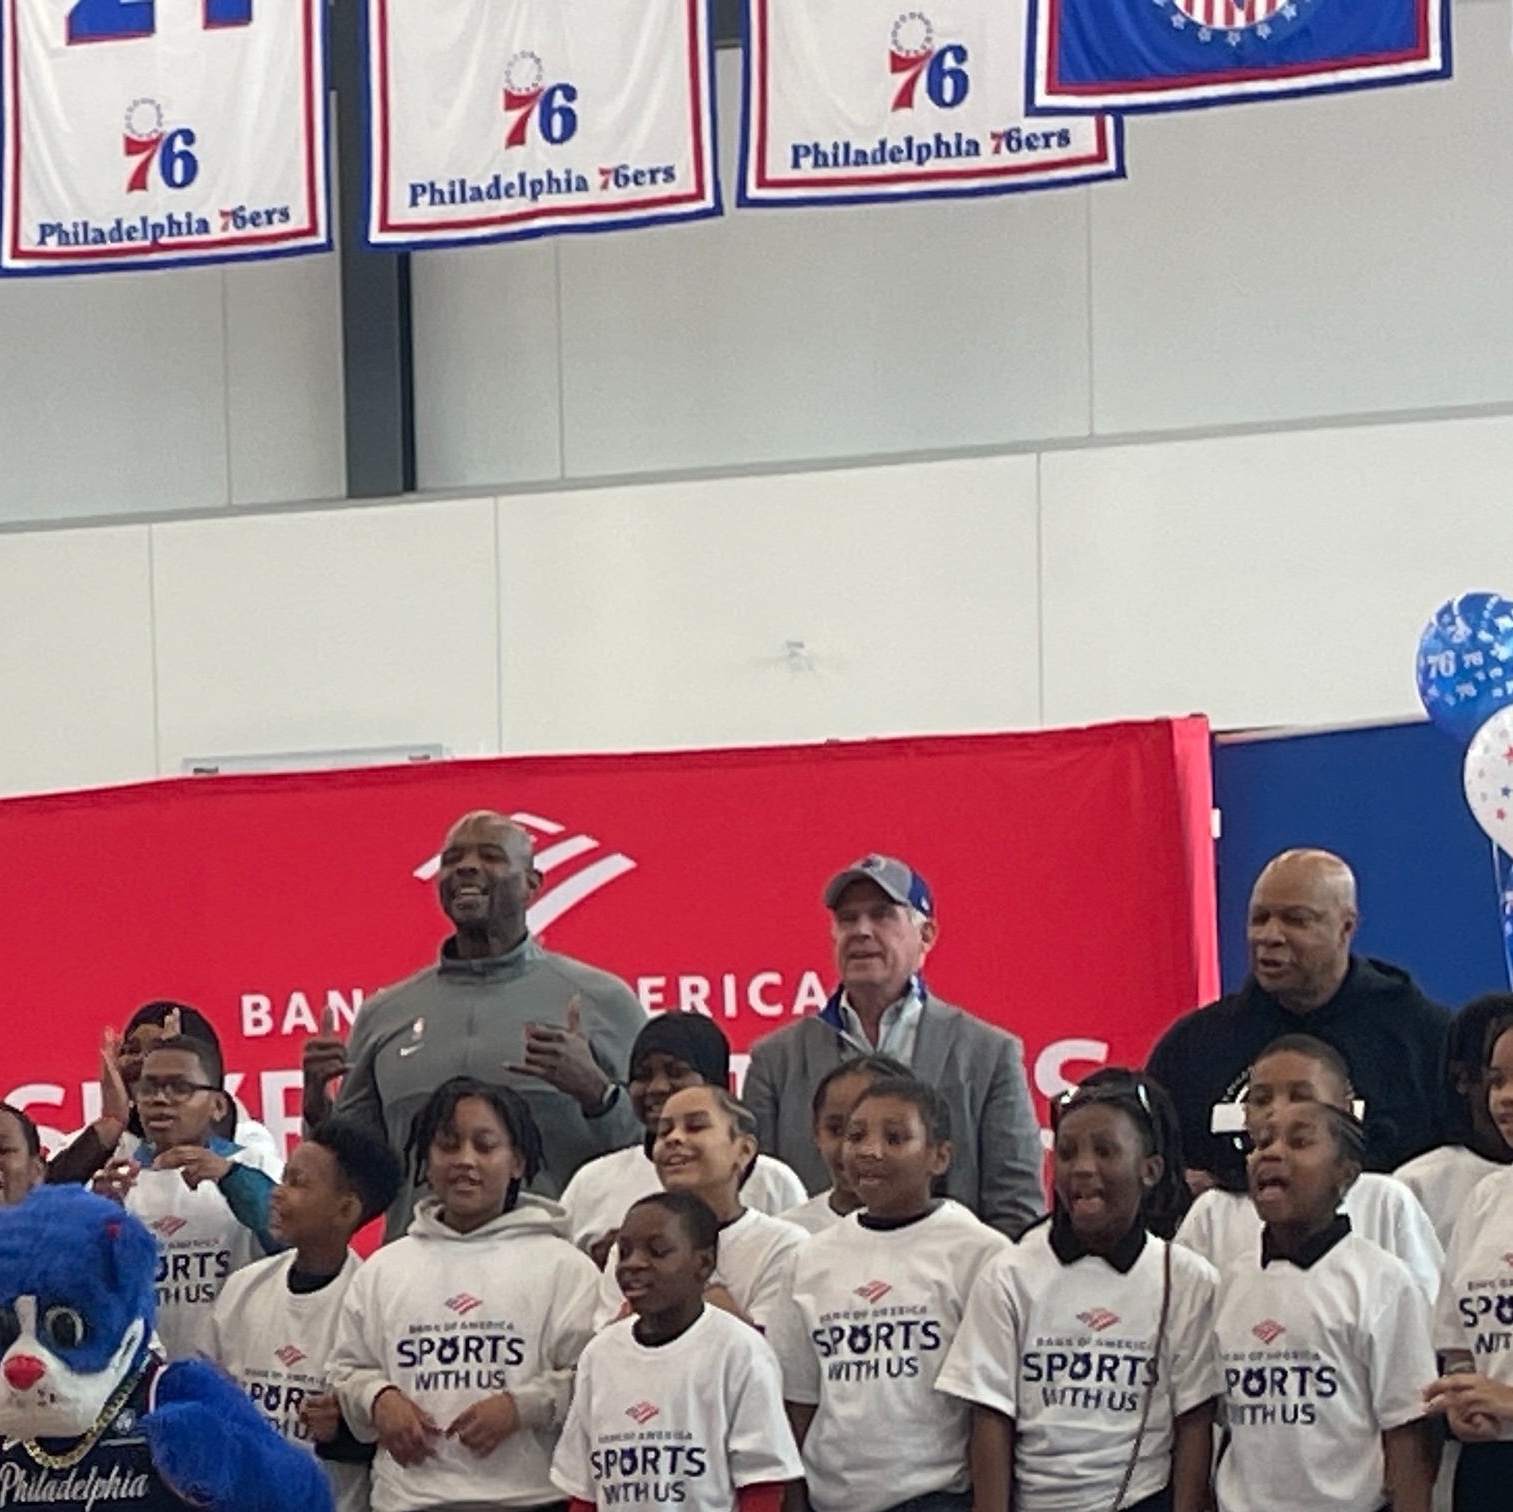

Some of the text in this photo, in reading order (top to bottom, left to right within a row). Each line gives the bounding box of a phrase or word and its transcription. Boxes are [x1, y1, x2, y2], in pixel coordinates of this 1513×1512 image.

[889, 43, 970, 113] 76
[503, 82, 579, 149] 76
[122, 127, 199, 194] 76
[790, 127, 1071, 172] Philadelphia 76ers
[408, 163, 677, 208] Philadelphia 76ers
[36, 204, 291, 248] Philadelphia 76ers
[240, 970, 828, 1038] BAN ERICA
[155, 1249, 232, 1283] ORTS
[397, 1334, 526, 1368] SPORTS
[812, 1320, 942, 1358] SPORTS
[414, 1369, 506, 1391] WITH US
[828, 1355, 920, 1382] WITH US
[1022, 1351, 1160, 1387] SPORTS
[1224, 1365, 1338, 1399] PORTS
[1042, 1386, 1139, 1412] WITH US
[1280, 1402, 1317, 1425] US
[589, 1445, 707, 1480] SPORTS
[653, 1480, 687, 1502] US
